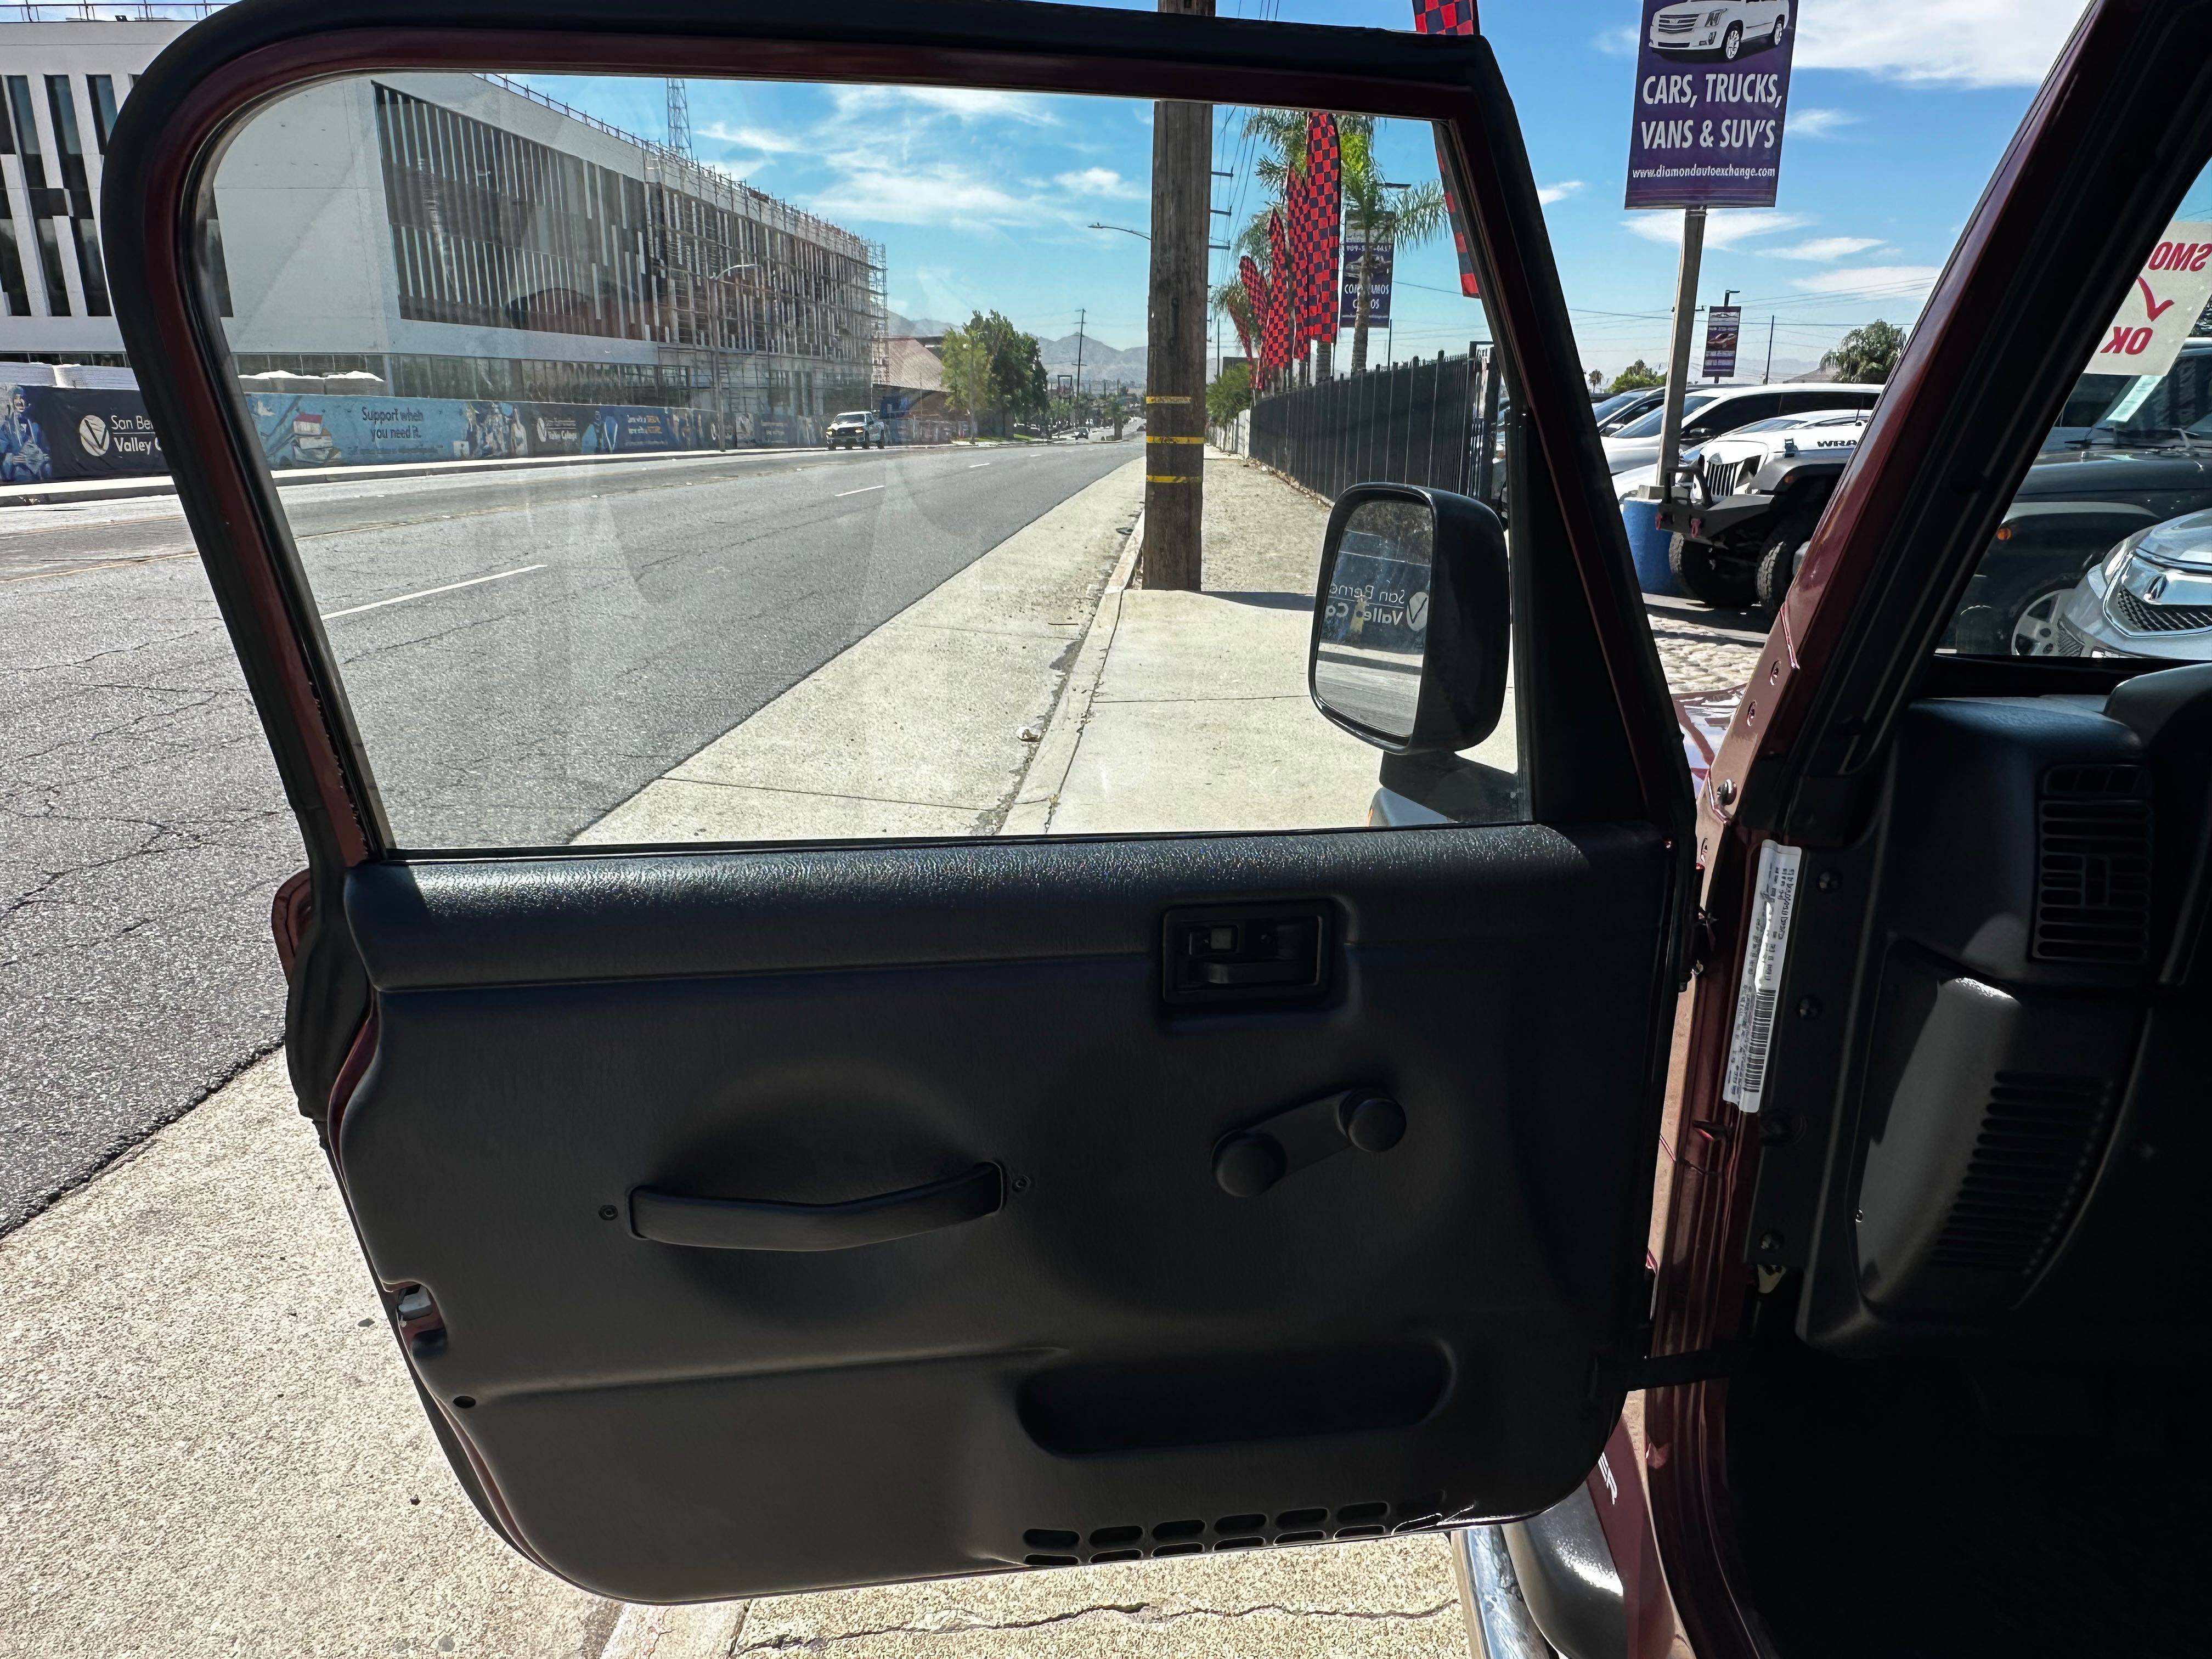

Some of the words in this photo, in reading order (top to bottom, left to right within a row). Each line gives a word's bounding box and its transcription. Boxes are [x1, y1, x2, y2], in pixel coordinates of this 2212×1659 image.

[1643, 75, 1698, 108] CARS,
[1706, 74, 1782, 108] TRUCKS,
[1641, 120, 1694, 149] VANS
[1700, 120, 1714, 148] &
[1719, 119, 1776, 148] SUV'S
[1633, 163, 1775, 179] www.diamondautoexchange.com
[111, 415, 133, 430] San
[362, 407, 399, 425] Support
[371, 428, 388, 442] you
[390, 426, 411, 439] need
[114, 437, 151, 455] Valley
